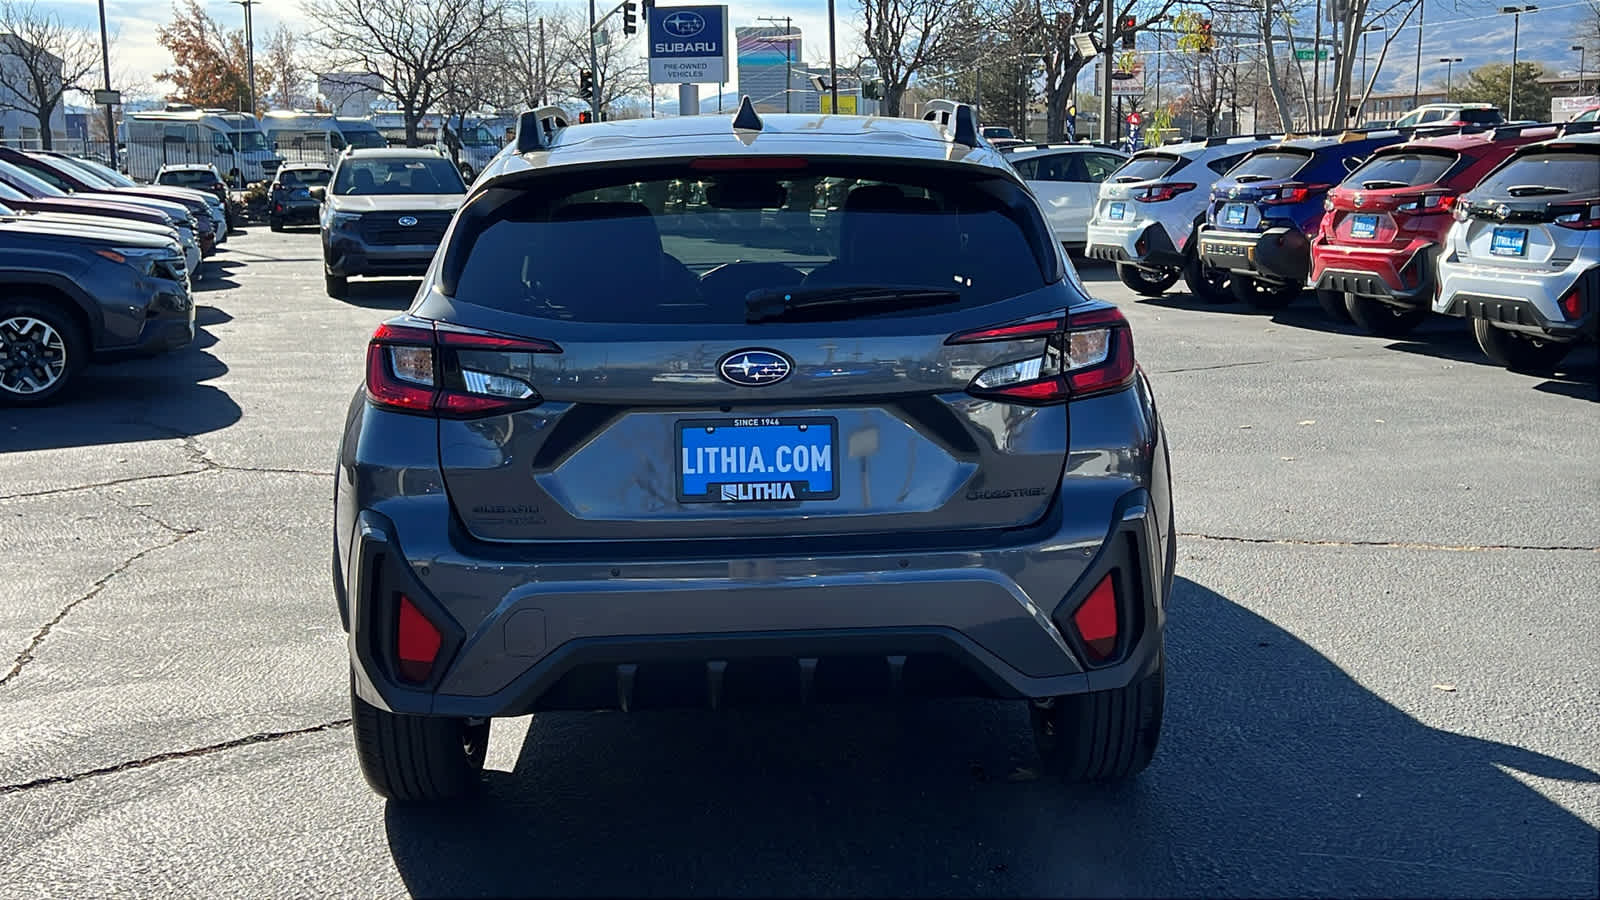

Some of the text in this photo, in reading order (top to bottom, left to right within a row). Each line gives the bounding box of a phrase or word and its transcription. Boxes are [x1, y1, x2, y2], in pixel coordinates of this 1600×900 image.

[655, 42, 716, 53] SUBARU
[761, 418, 780, 426] 1946
[682, 445, 831, 474] LITHIA.COM
[737, 482, 796, 500] LITHIA
